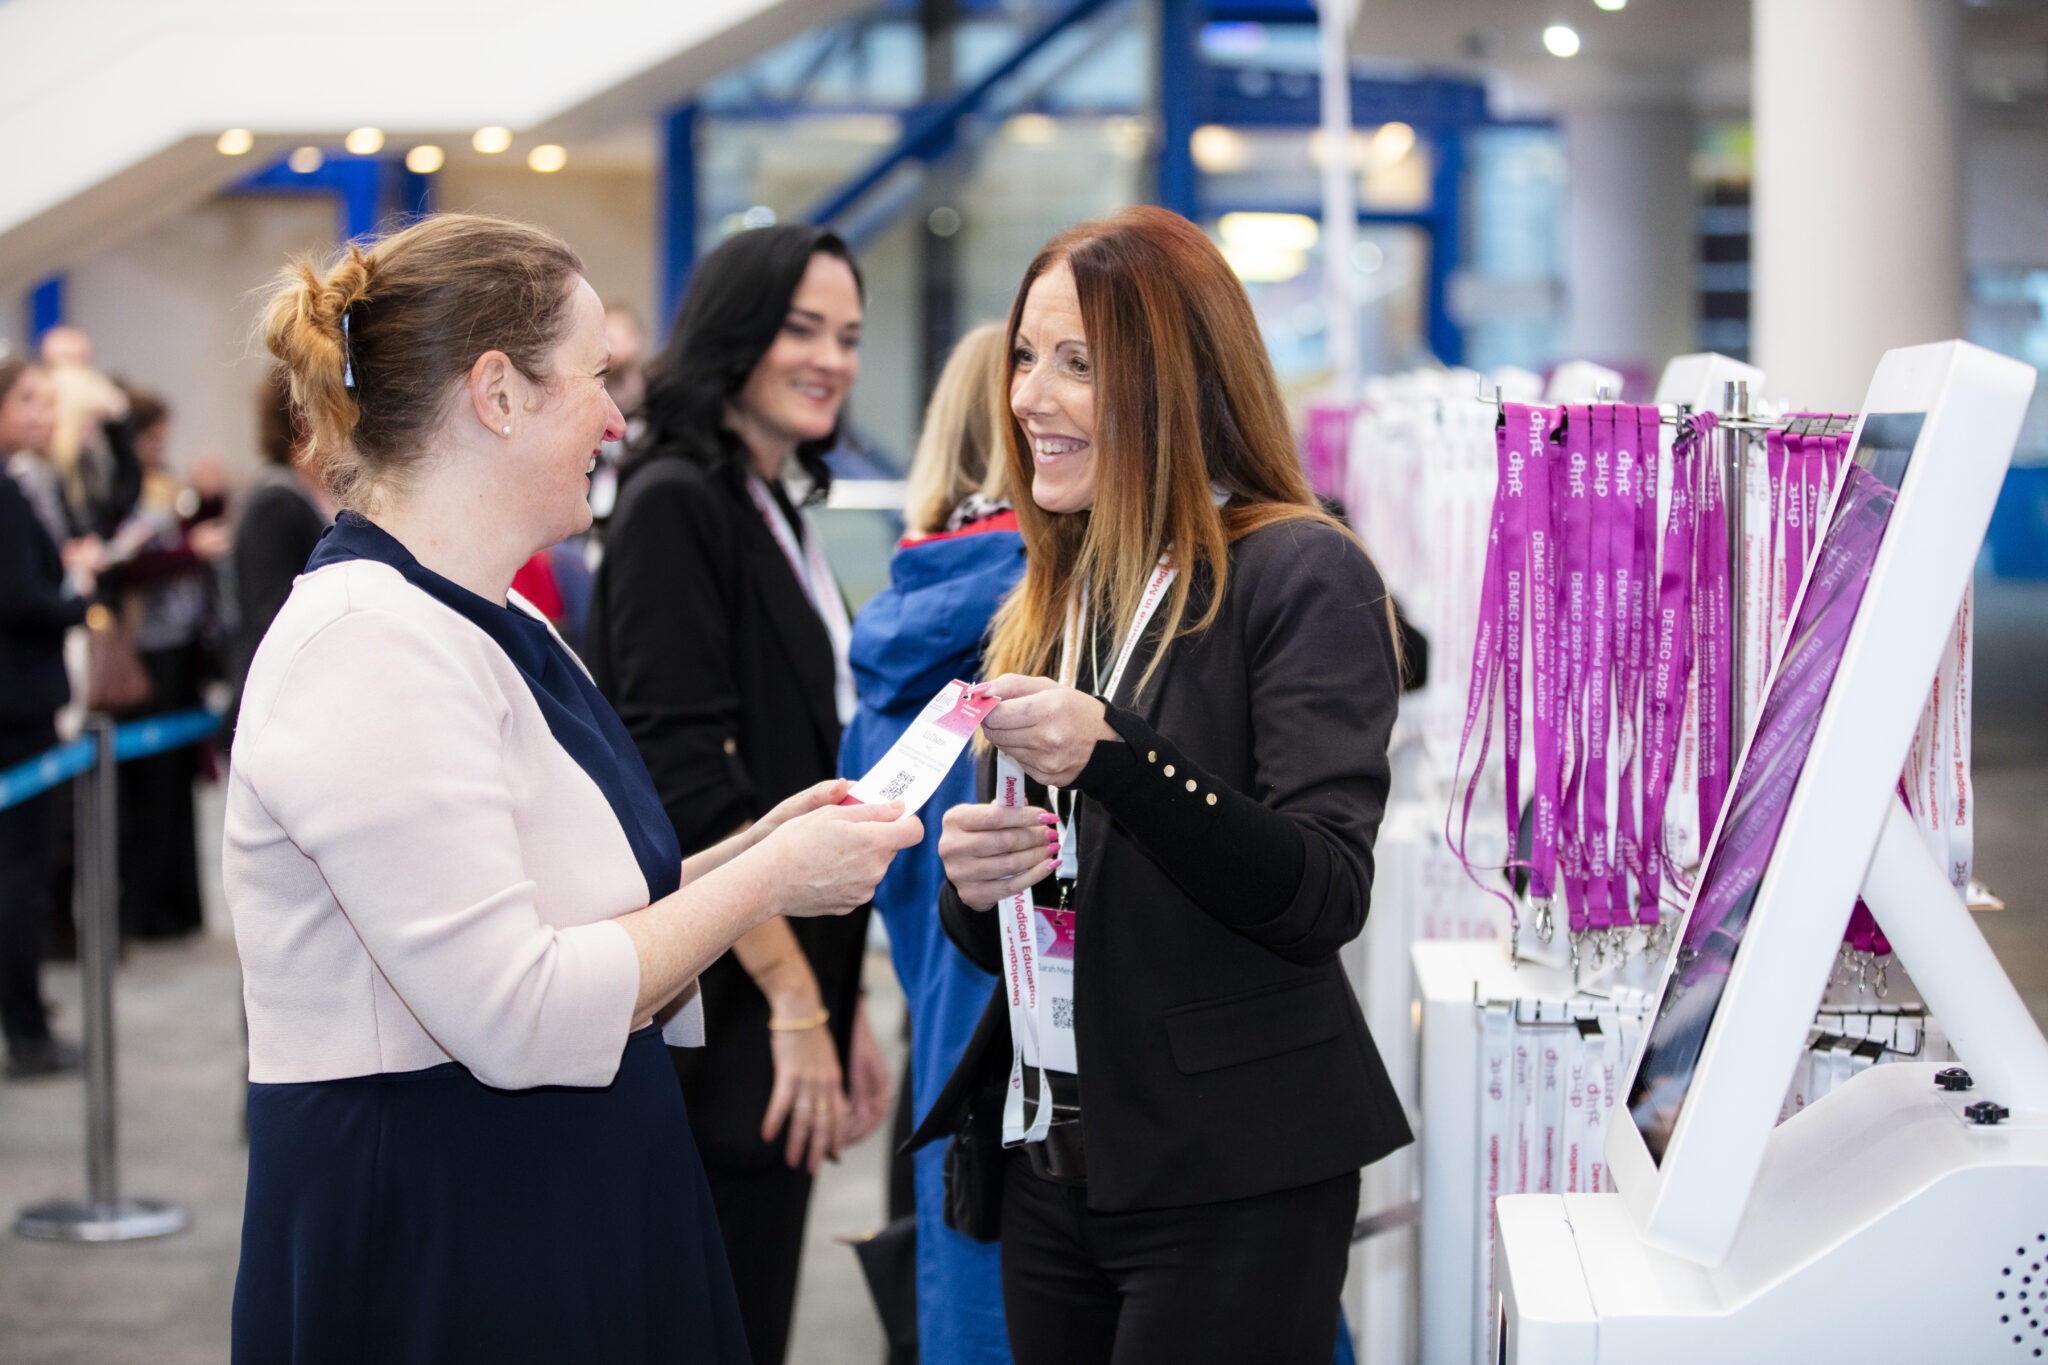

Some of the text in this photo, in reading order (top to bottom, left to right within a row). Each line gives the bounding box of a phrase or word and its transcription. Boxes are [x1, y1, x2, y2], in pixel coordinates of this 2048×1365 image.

[1143, 598, 1153, 610] in
[1149, 567, 1170, 596] Medi
[1571, 571, 1583, 622] DEMEC
[1616, 568, 1628, 620] DEMEC
[1475, 620, 1491, 669] Author
[1532, 531, 1547, 720] DEMEC 2025 Poster Author
[1572, 624, 1582, 660] 2025
[1616, 622, 1626, 658] 2025
[1659, 608, 1675, 660] DEMEC
[1508, 571, 1521, 759] DEMEC 2025 Poster Author
[1592, 570, 1605, 759] DEMEC 2025 Poster Author
[1655, 662, 1670, 699] 2025
[1655, 701, 1667, 748] Poster
[1005, 776, 1018, 807] Developin
[1647, 749, 1664, 799] Author
[1955, 760, 1967, 827] Developing
[1013, 891, 1036, 1009] Medical Education
[1568, 1143, 1579, 1193] ducation
